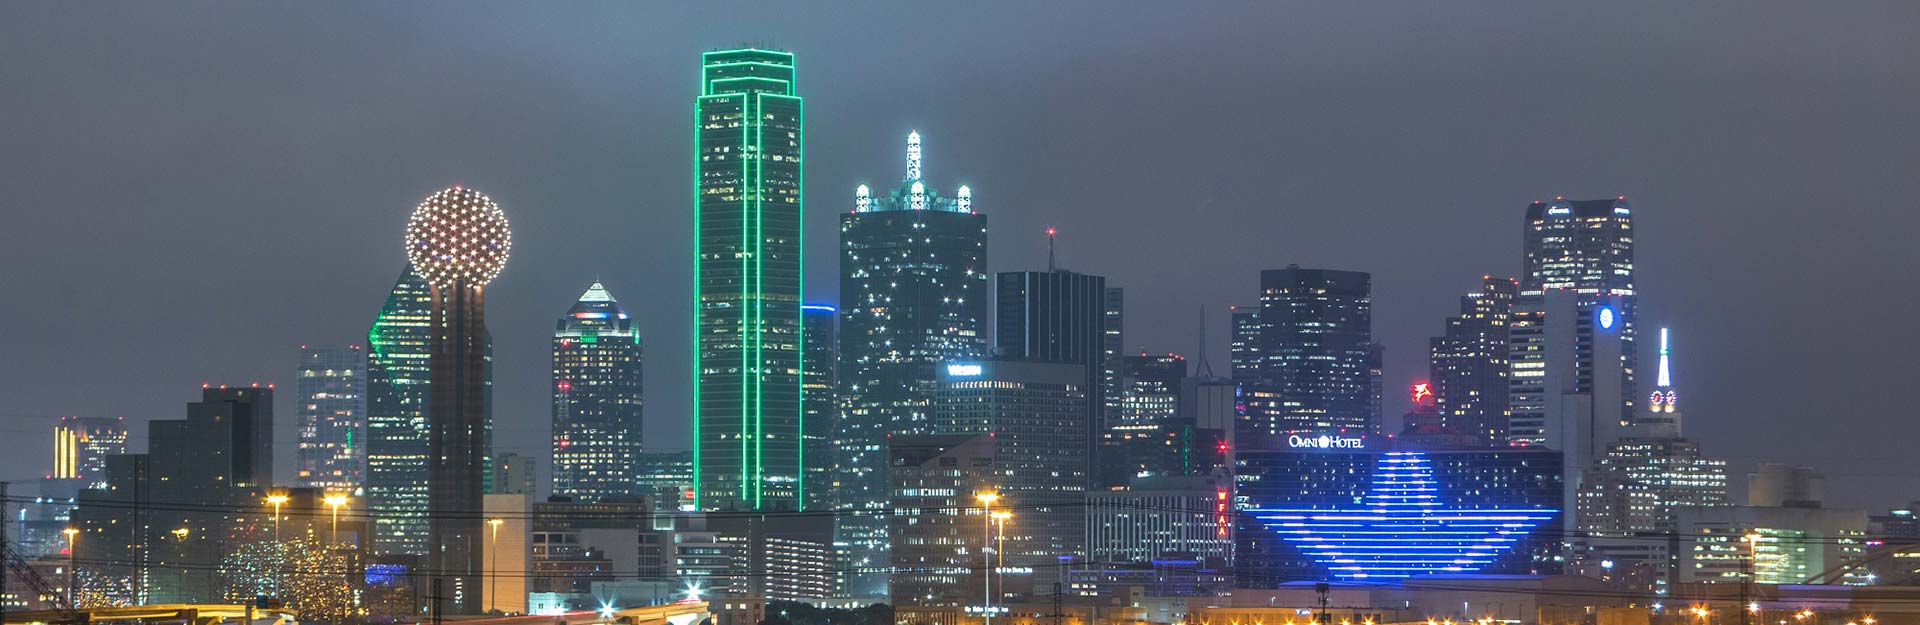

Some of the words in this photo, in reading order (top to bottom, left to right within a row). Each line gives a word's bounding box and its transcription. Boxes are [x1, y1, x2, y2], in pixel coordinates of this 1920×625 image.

[1288, 434, 1318, 448] OMNI
[1329, 435, 1365, 449] HOTEL
[1218, 491, 1227, 537] WFAA
